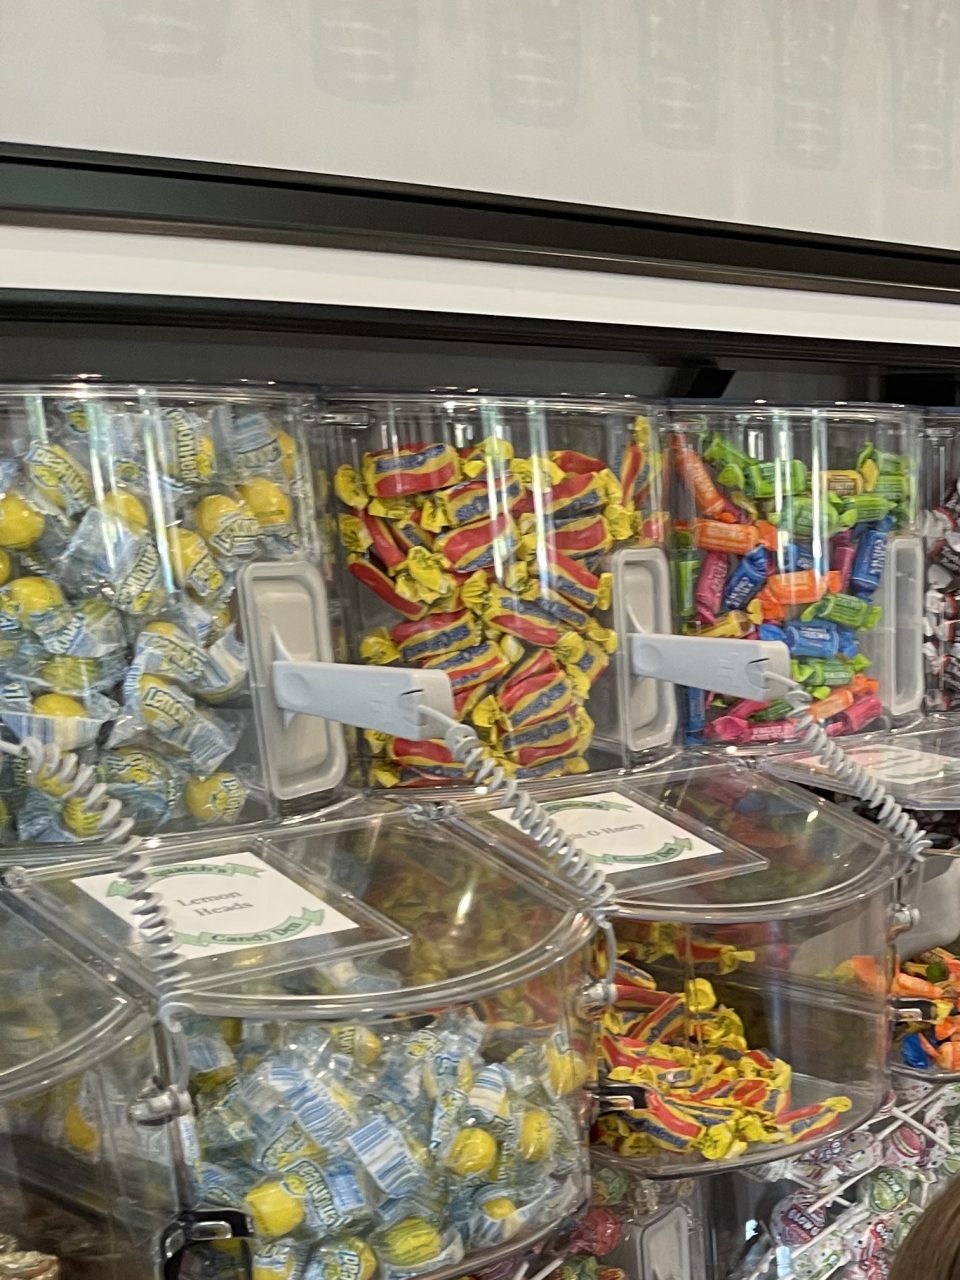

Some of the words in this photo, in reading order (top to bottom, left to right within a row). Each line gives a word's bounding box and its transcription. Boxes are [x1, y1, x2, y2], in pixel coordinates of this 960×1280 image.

[176, 890, 242, 907] Lemon
[192, 901, 253, 917] Heads
[211, 930, 272, 944] Candy
[272, 921, 303, 938] Den
